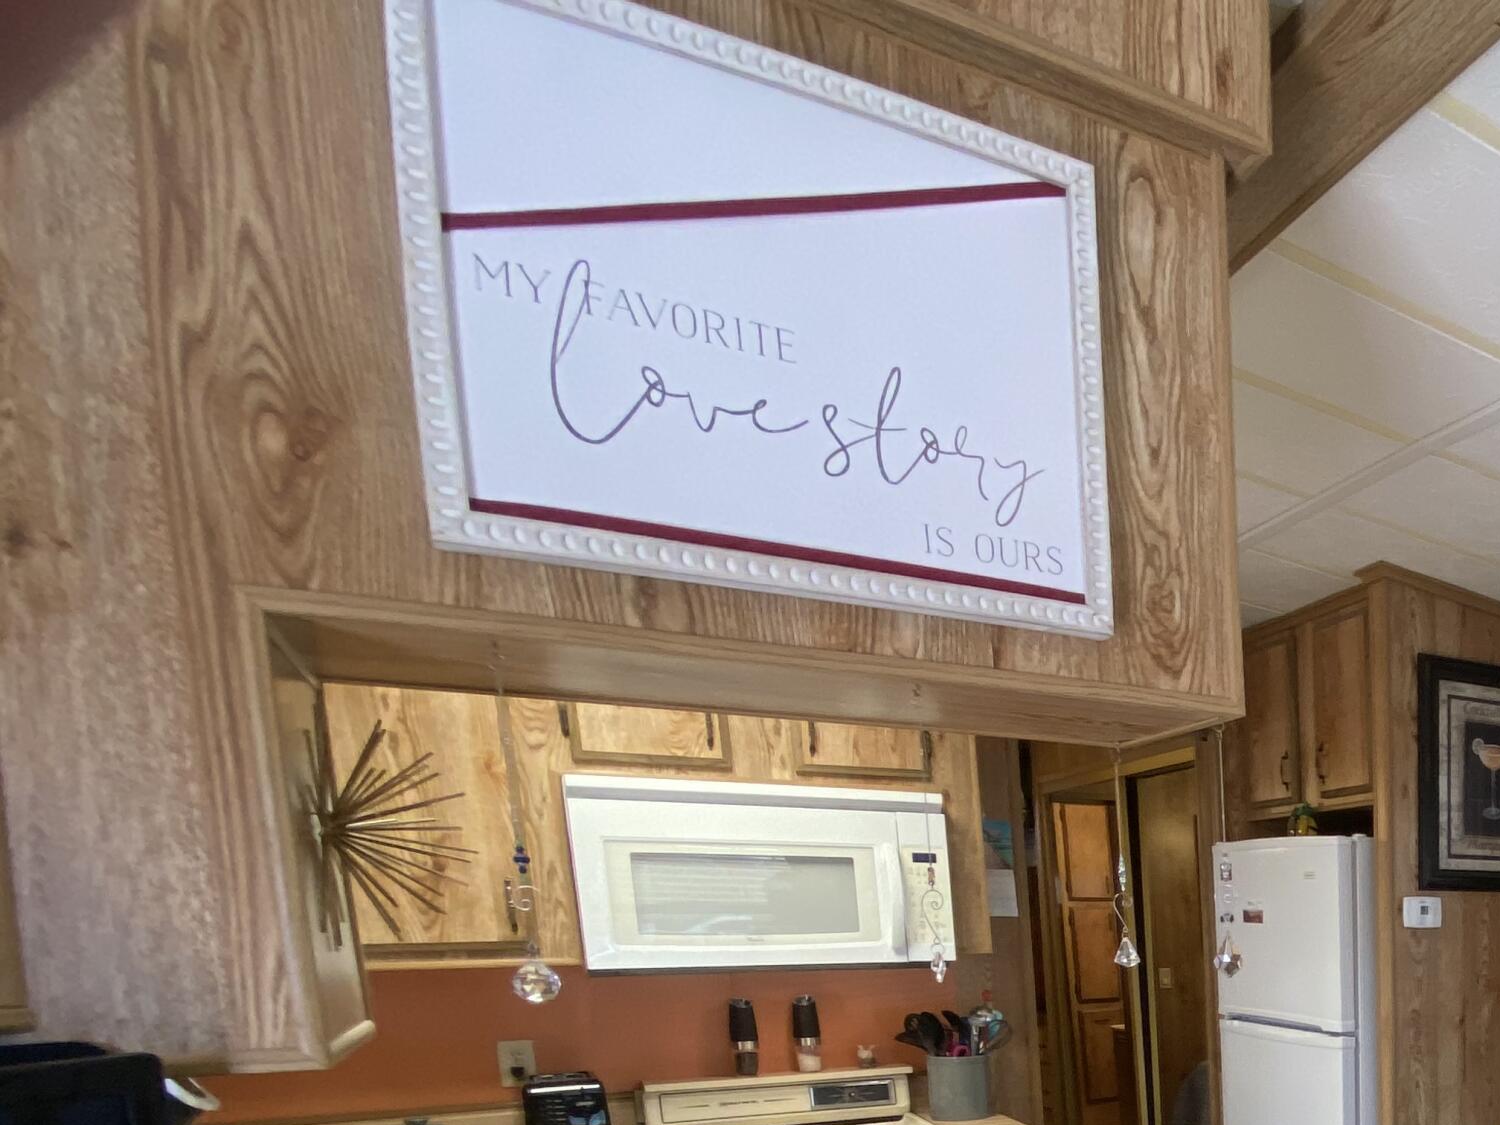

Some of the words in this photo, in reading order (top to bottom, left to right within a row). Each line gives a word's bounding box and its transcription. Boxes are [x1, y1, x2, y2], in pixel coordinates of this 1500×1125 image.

[470, 253, 553, 305] MY
[579, 278, 798, 364] FAVORITE
[922, 523, 956, 558] IS
[974, 530, 1066, 577] OURS
